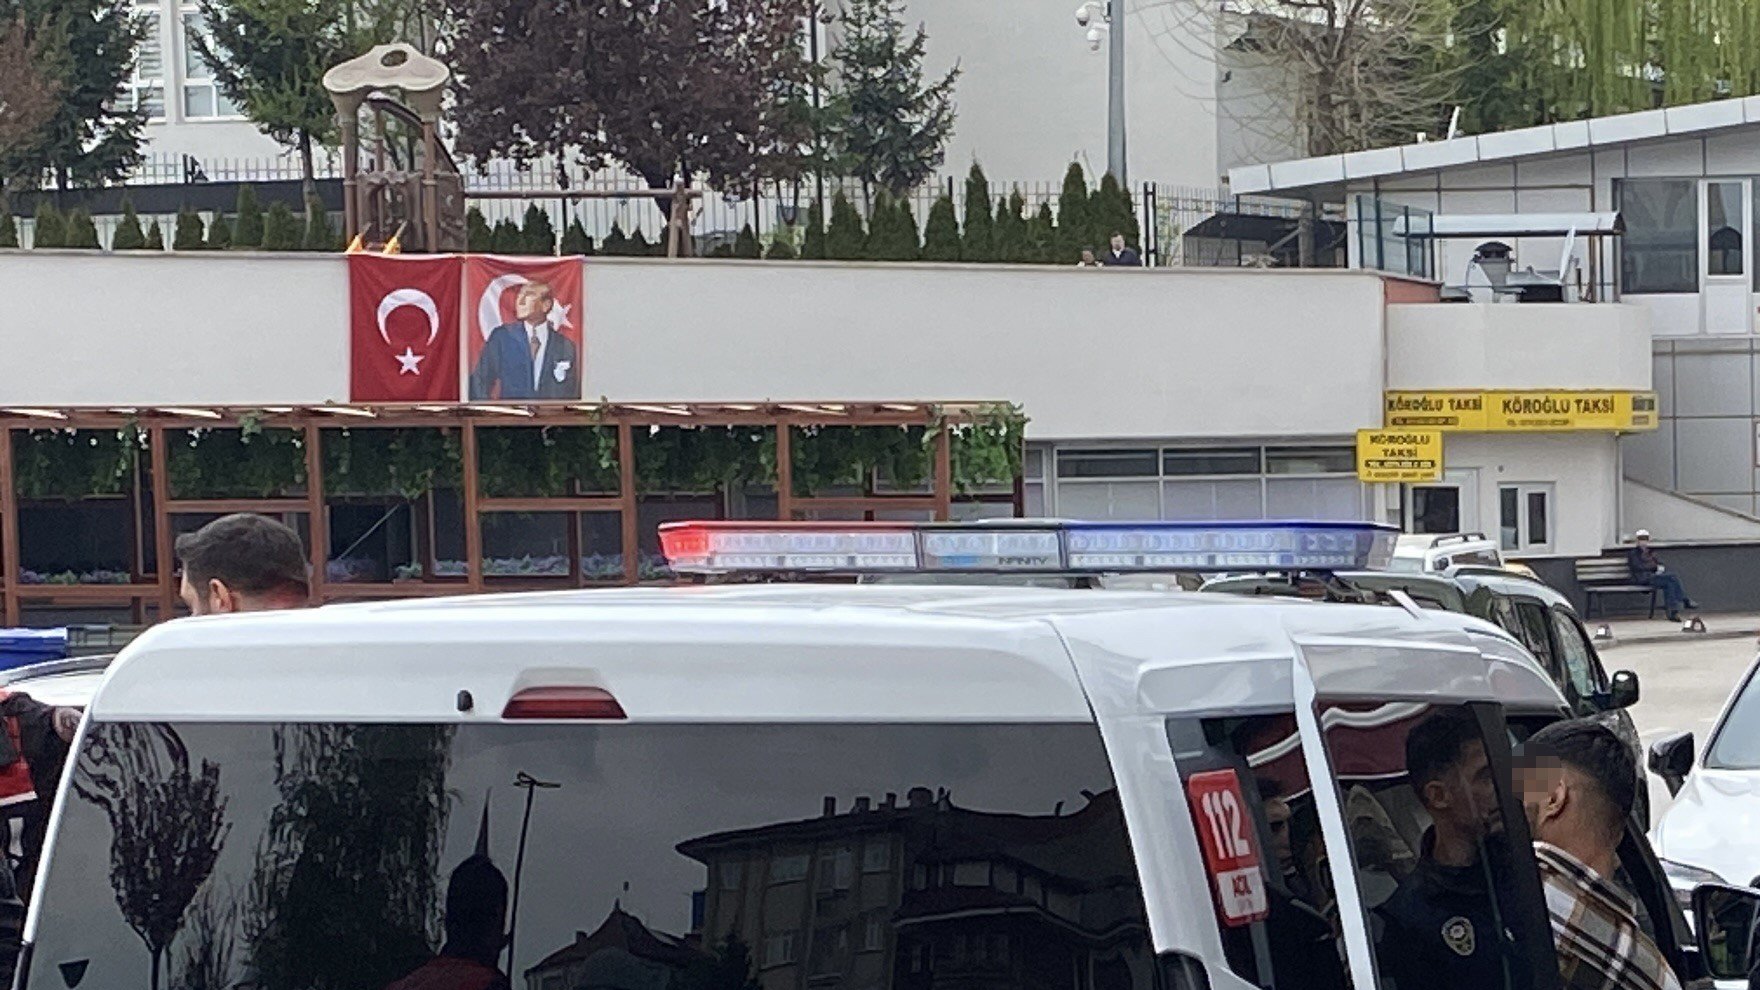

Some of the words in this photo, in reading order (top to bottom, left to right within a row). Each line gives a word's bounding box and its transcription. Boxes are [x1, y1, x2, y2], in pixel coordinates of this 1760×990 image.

[1502, 396, 1571, 414] KÖROĞLU
[1574, 395, 1614, 413] TAKSİ
[1201, 789, 1251, 860] 112
